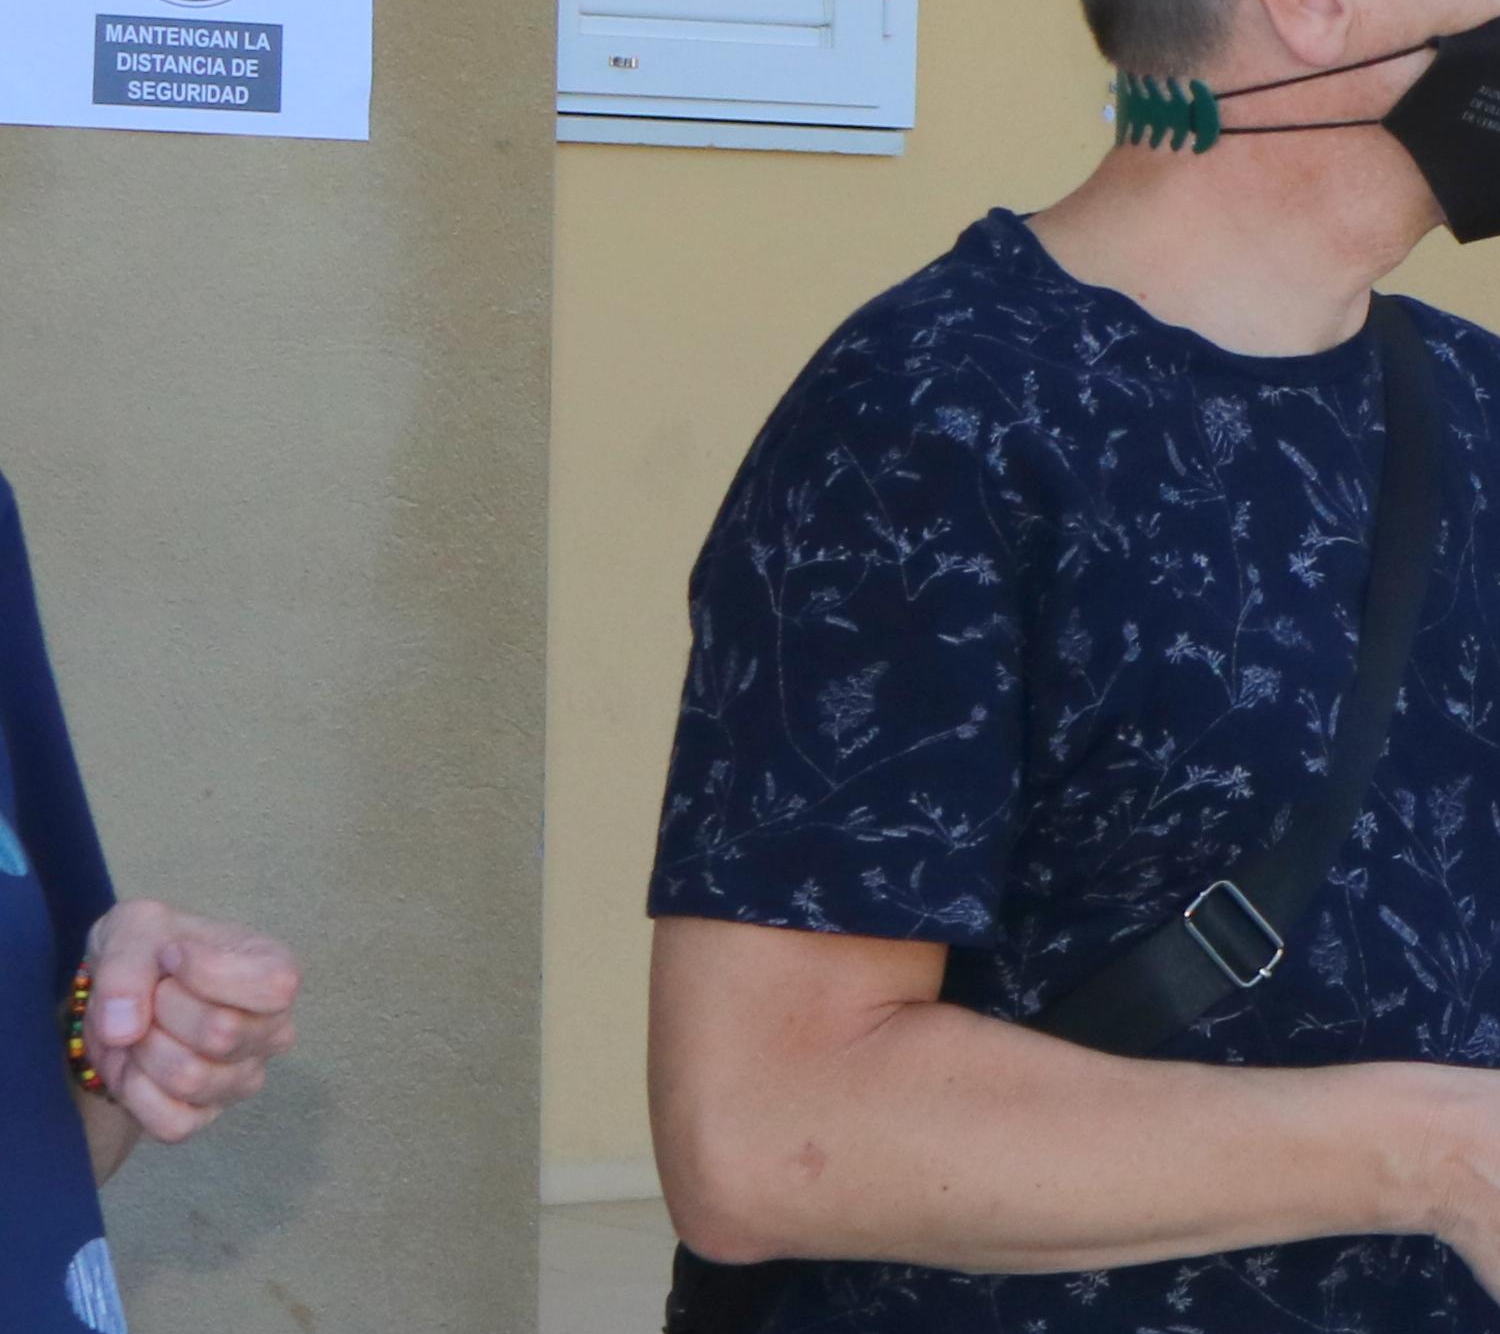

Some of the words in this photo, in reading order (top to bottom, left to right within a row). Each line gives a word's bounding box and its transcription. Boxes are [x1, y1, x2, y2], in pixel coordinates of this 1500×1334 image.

[105, 23, 239, 50] MANTENGAN
[244, 31, 272, 52] LA
[116, 51, 226, 77] DISTANCIA
[231, 58, 260, 78] DE
[127, 80, 250, 105] SEGURIDAD
